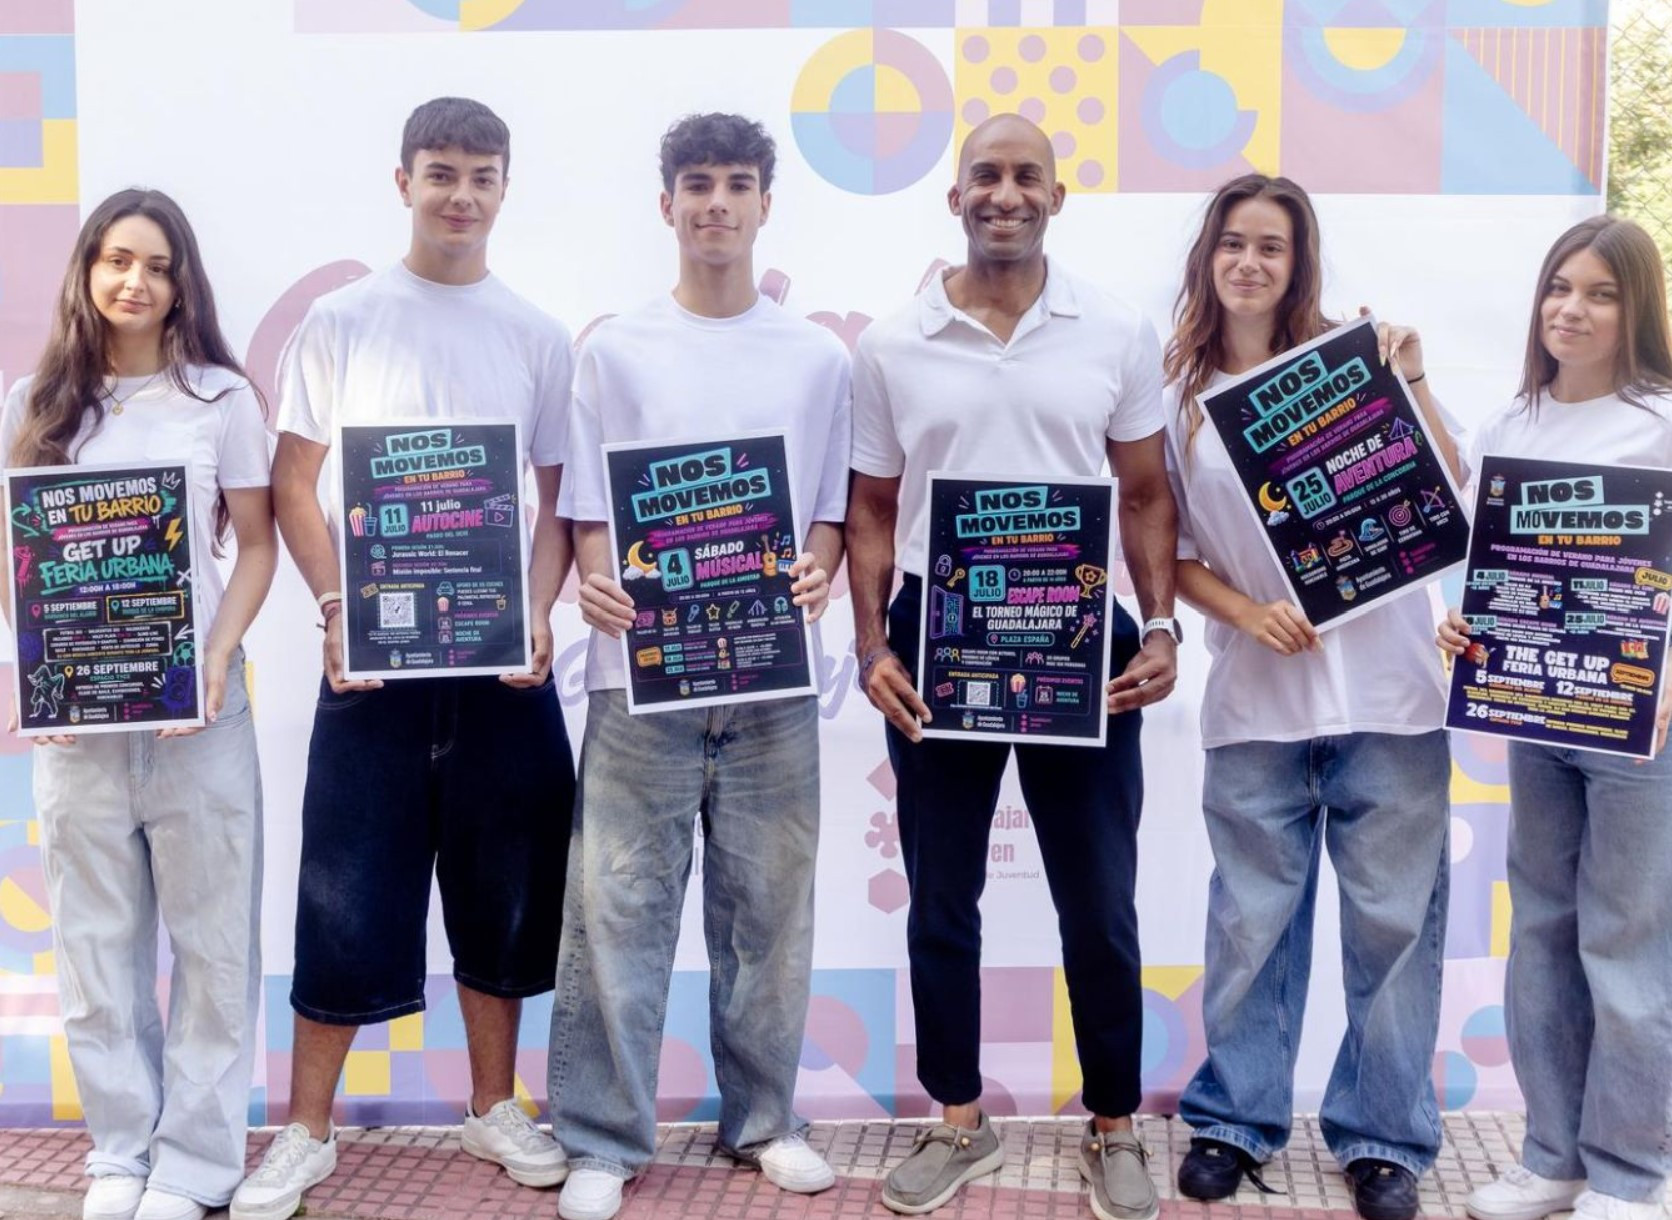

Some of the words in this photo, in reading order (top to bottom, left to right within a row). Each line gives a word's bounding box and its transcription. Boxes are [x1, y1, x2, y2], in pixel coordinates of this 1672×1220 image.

[1256, 358, 1321, 412] NOS
[1248, 364, 1365, 448] MOVEMOS
[1287, 432, 1304, 446] EN
[1302, 422, 1318, 437] TU
[1317, 398, 1357, 428] BARRIO
[391, 432, 448, 453] NOS
[375, 449, 483, 475] MOVEMOS
[1325, 445, 1368, 475] NOCHE
[1365, 433, 1384, 453] DE
[655, 454, 727, 488] NOS
[1333, 436, 1418, 495] AVENTURA
[403, 475, 417, 484] EN
[418, 473, 430, 482] TU
[432, 470, 465, 481] BARRIO
[1293, 473, 1324, 501] 25
[1366, 483, 1374, 491] DE
[1375, 478, 1383, 487] LA
[41, 488, 75, 509] NOS
[79, 477, 158, 503] MOVEMOS
[637, 474, 767, 518] MOVEMOS
[980, 491, 1042, 510] NOS
[1527, 480, 1595, 503] NOS
[48, 510, 68, 525] EN
[69, 506, 92, 524] TU
[97, 495, 161, 519] BARRIO
[420, 501, 433, 512] 11
[435, 499, 461, 513] julio
[1303, 494, 1332, 515] JULIO
[384, 508, 402, 524] 11
[411, 508, 484, 533] AUTOCINE
[675, 516, 689, 526] EN
[690, 511, 704, 522] TU
[706, 504, 743, 519] BARRIO
[960, 511, 1076, 534] MOVEMOS
[1516, 510, 1644, 529] MOVEMOS
[384, 524, 406, 533] JULIO
[63, 539, 106, 562] GET
[112, 535, 141, 556] UP
[991, 536, 1004, 545] EN
[1006, 535, 1019, 544] TU
[1020, 533, 1054, 543] BARRIO
[1538, 535, 1554, 545] EN
[1557, 535, 1573, 545] TU
[1576, 535, 1622, 545] BARRIO
[694, 540, 744, 560] SÁBADO
[1490, 544, 1549, 556] PROGRAMACIÓN
[1551, 550, 1561, 558] DE
[1563, 552, 1593, 562] VERANO
[1595, 555, 1616, 564] PARA
[1617, 556, 1652, 567] JÓVENES
[39, 560, 98, 587] FERIA
[101, 553, 175, 580] URBANA
[667, 553, 683, 575] 4
[696, 551, 763, 581] MÚSICAL
[1507, 553, 1516, 561] EN
[1518, 554, 1532, 563] LOS
[1534, 556, 1567, 566] BARRIOS
[1569, 559, 1579, 567] DE
[1580, 560, 1635, 573] GUADALAJARA
[666, 575, 690, 587] JULIO
[975, 570, 999, 587] 18
[1476, 571, 1485, 579] 4
[1486, 571, 1506, 580] JULIO
[1642, 572, 1667, 585] JULIO
[121, 599, 131, 608] 12
[132, 597, 177, 607] SEPTIEMBRE
[973, 588, 1002, 597] JULIO
[1007, 586, 1046, 604] ESCAPE
[1046, 585, 1081, 603] ROOM
[43, 603, 50, 614] 5
[51, 601, 98, 612] SEPTIEMBRE
[972, 606, 983, 619] EL
[986, 606, 1022, 618] TORNEO
[1024, 603, 1063, 617] MÁGICO
[1064, 605, 1078, 617] DE
[987, 618, 1062, 631] GUADALAJARA
[1474, 617, 1495, 625] JULIO
[1567, 615, 1583, 623] 25
[1583, 615, 1605, 623] JULIO
[1001, 635, 1022, 643] PLAZA
[1024, 633, 1050, 643] ESPAÑA
[1505, 645, 1540, 663] THE
[1544, 650, 1580, 667] GET
[1583, 654, 1610, 671] UP
[76, 665, 91, 676] 26
[93, 661, 159, 674] SEPTIEMBRE
[1502, 660, 1543, 676] FERIA
[1547, 665, 1608, 685] URBANA
[1616, 669, 1650, 682] SEPTIEMBRE
[1475, 669, 1487, 684] 5
[1487, 674, 1546, 690] SEPTIEMBRE
[1556, 681, 1574, 696] 12
[1574, 685, 1634, 702] SEPTIEMBRE
[1466, 703, 1489, 719] 26
[1488, 709, 1547, 725] SEPTIEMBRE
[996, 871, 1040, 879] Juventud
